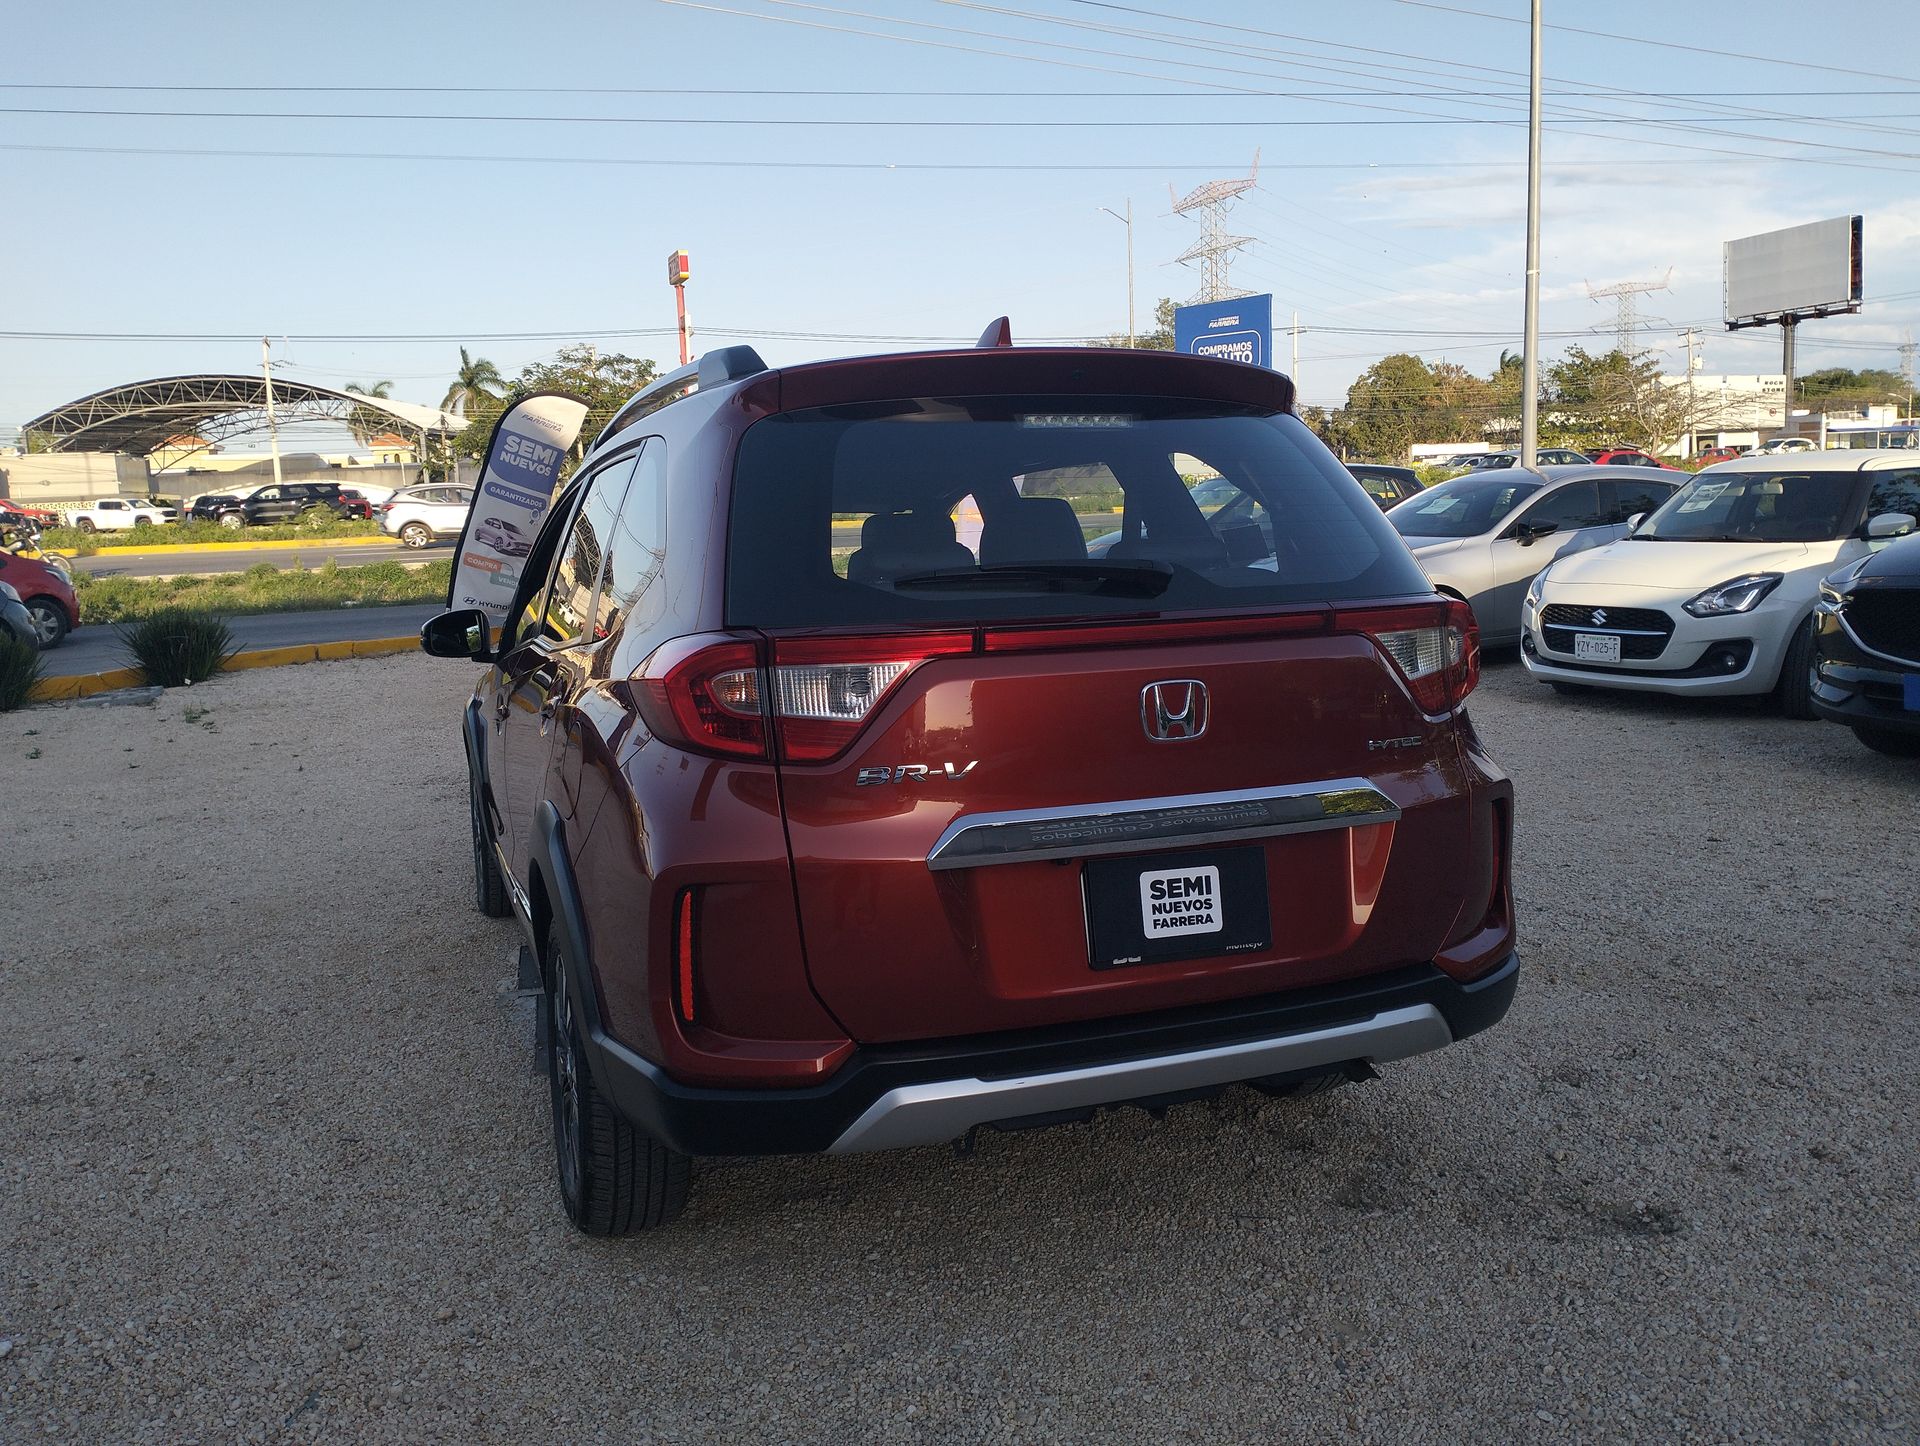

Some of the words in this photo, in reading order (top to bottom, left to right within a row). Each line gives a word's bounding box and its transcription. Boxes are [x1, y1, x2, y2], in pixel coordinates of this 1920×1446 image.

[1198, 341, 1253, 355] COMPRAMOS
[521, 414, 562, 433] FARRERA
[504, 435, 558, 466] SEMI
[500, 450, 553, 477] NUEVOS
[490, 486, 543, 508] GARANTIZADOS
[467, 556, 499, 571] COMPRA
[1576, 640, 1618, 655] YZY-025-F
[856, 760, 981, 786] BR-V
[1150, 875, 1212, 901] SEMI
[1151, 898, 1213, 916] NUEVOS
[1153, 913, 1215, 930] FARRERA
